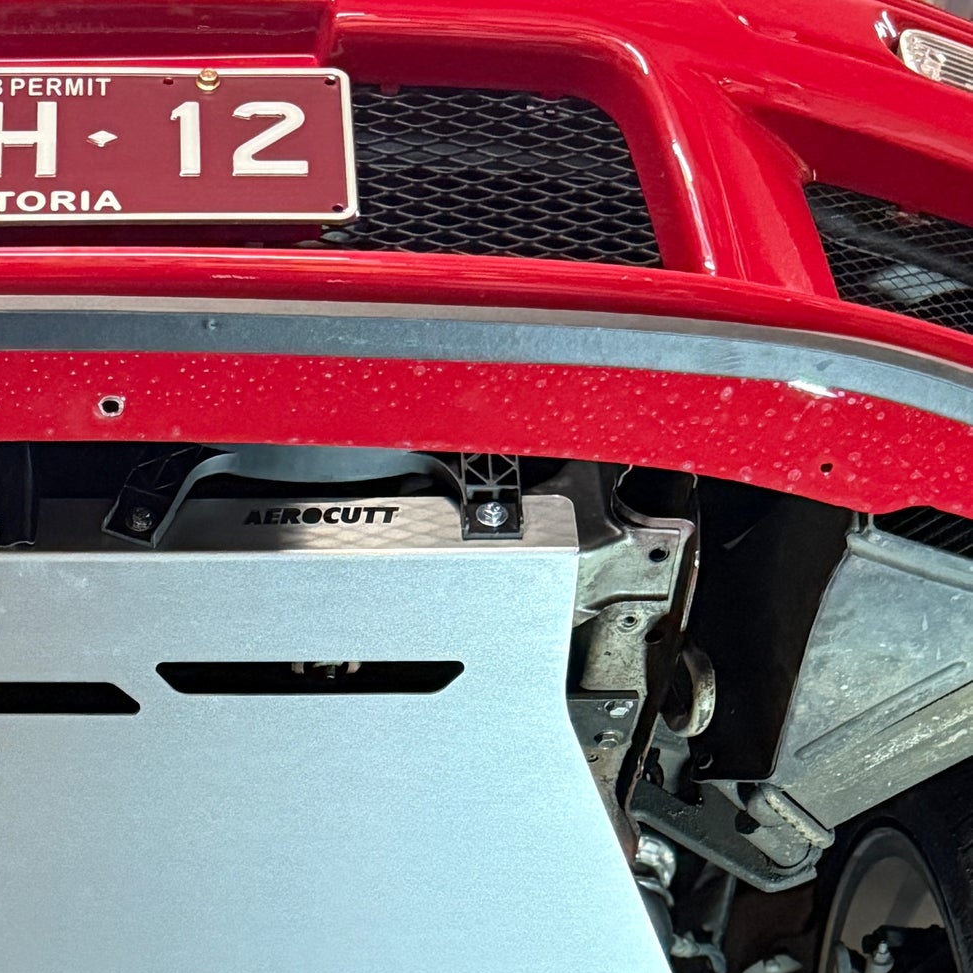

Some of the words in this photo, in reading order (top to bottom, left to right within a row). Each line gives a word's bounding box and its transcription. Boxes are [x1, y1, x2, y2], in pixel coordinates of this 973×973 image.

[12, 78, 111, 96] PERMIT
[170, 102, 309, 177] 12
[244, 506, 400, 525] AEROCUTT
